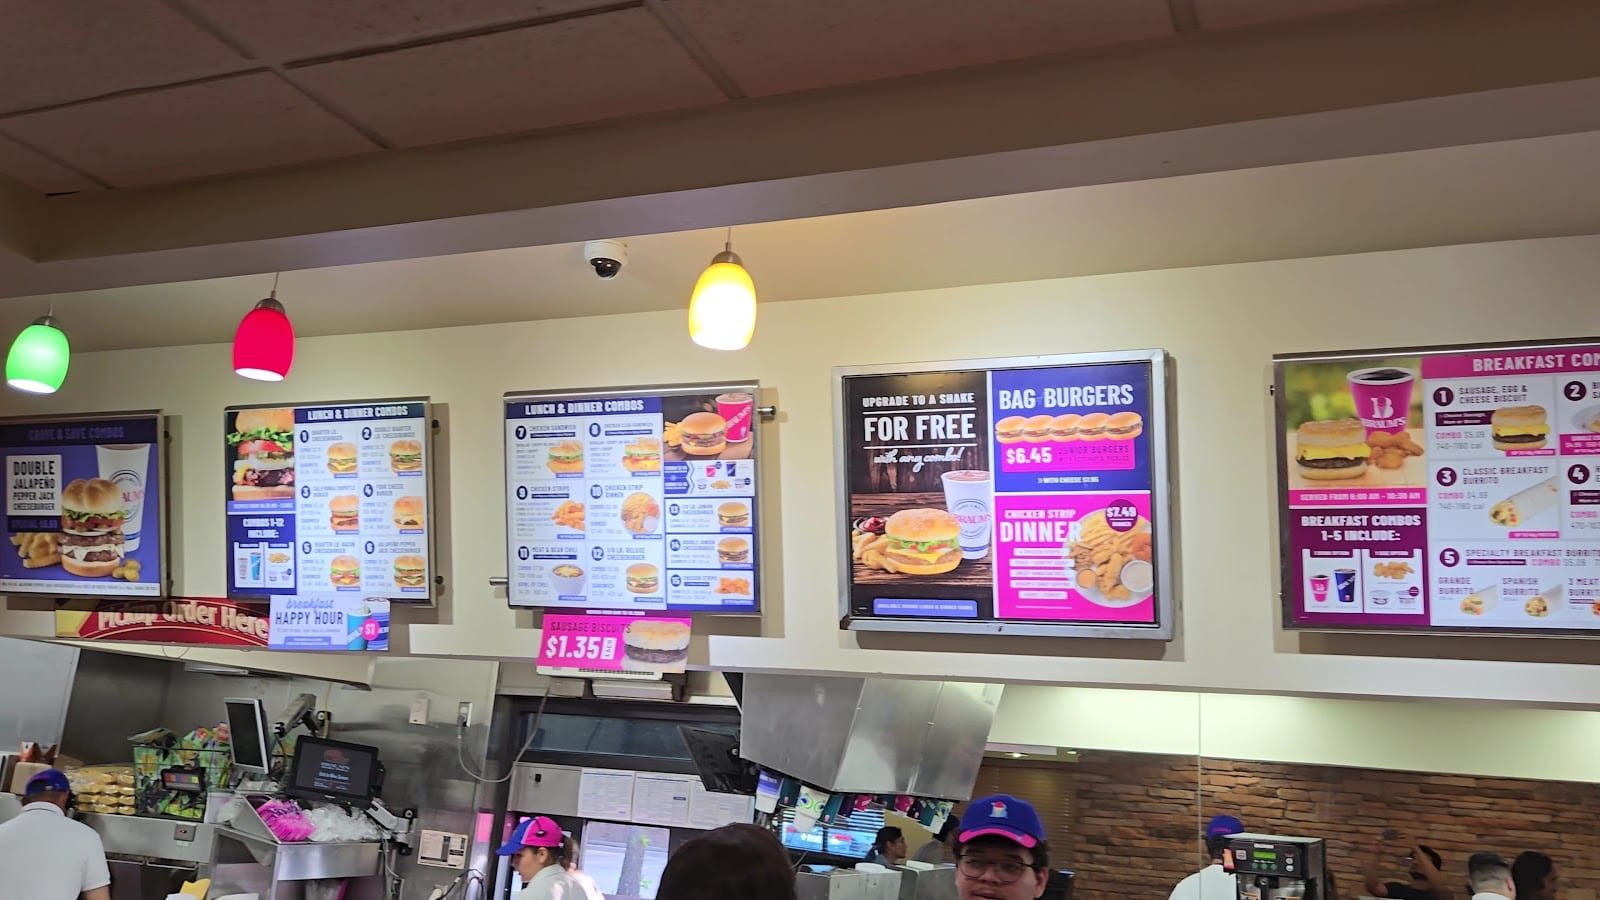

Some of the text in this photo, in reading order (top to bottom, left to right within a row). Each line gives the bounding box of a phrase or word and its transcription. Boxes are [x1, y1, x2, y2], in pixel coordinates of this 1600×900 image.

[1472, 354, 1566, 372] BREAKFAST
[1459, 384, 1528, 395] SAUSAGE, EGG &
[862, 393, 976, 408] UPGRADE TO A SHAKE
[999, 384, 1134, 410] BAG BURGERS
[1459, 394, 1527, 404] CHEESE BISCUIT
[307, 405, 409, 421] LUNCH & DINNER COMBOS
[524, 399, 645, 415] LUNCH & DINNER COMBOS
[863, 413, 977, 442] FOR FREE
[1435, 432, 1462, 440] COMBO
[873, 448, 899, 464] with
[899, 455, 925, 473] any
[1006, 447, 1052, 464] $6.45
[13, 460, 56, 477] DOUBLE
[1462, 466, 1548, 476] CLASSIC BREAKFAST
[13, 476, 56, 490] JALAPEÑO
[1463, 476, 1499, 485] BURRITO
[12, 490, 56, 502] PEPPER JACK
[13, 502, 56, 512] CHEESEBURGER
[1106, 506, 1138, 518] $7.49
[1005, 509, 1077, 519] CHICKEN STRIP
[1301, 515, 1421, 526] BREAKFAST COMBOS
[1000, 521, 1082, 543] DINNER
[1321, 530, 1401, 541] 1-5 INCLUDE:
[1465, 549, 1511, 557] SPECIALTY
[1513, 549, 1562, 557] BREAKFAST
[98, 601, 269, 639] Pickup Order Here
[275, 611, 344, 625] HAPPY HOUR
[364, 623, 376, 636] $1
[550, 621, 632, 634] SAUSAGE BISCUITS
[544, 635, 601, 659] $1.35
